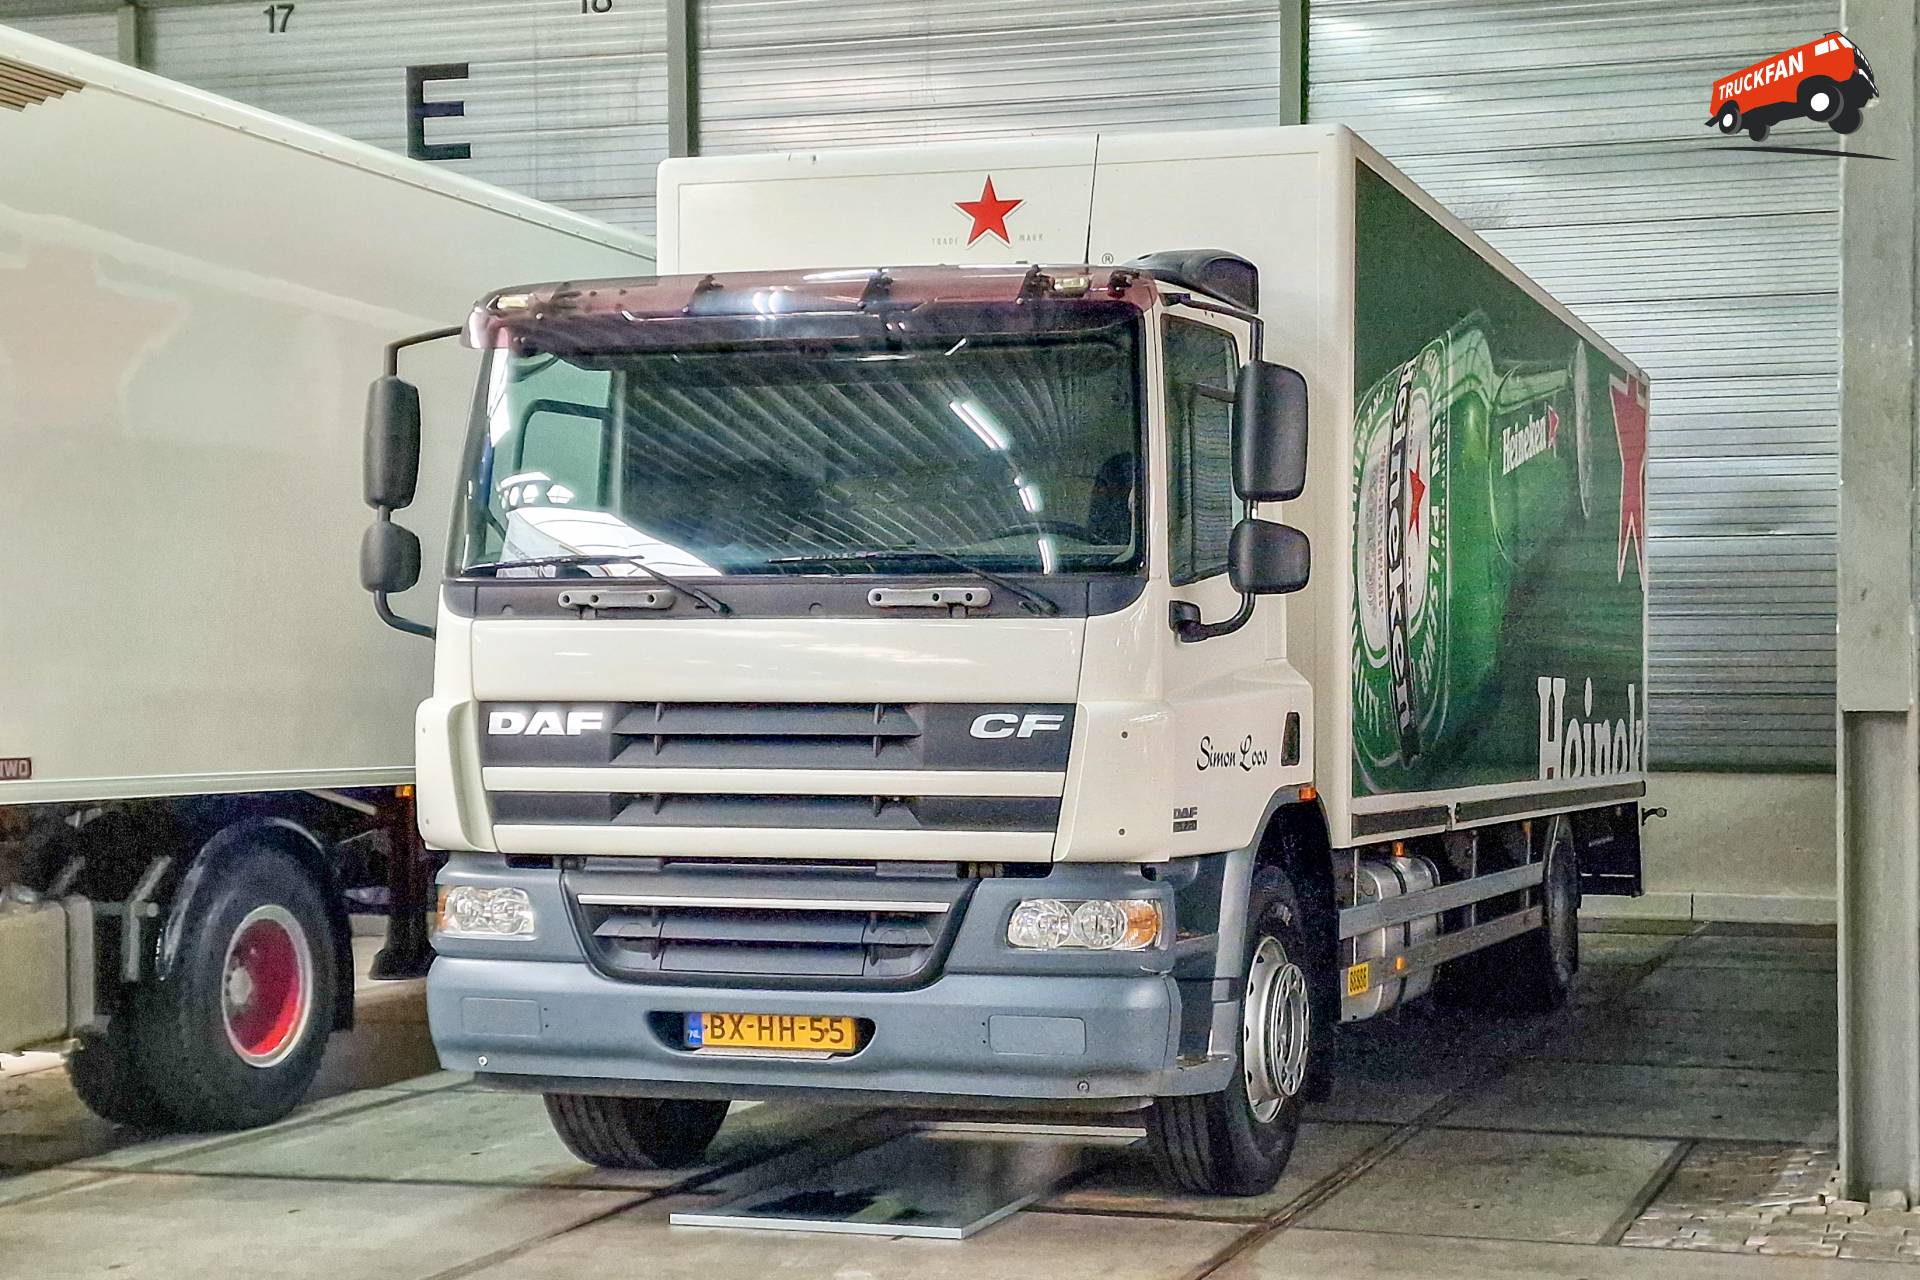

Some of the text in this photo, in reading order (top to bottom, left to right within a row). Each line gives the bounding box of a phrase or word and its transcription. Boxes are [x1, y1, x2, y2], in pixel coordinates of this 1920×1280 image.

[263, 4, 295, 33] 17
[405, 62, 472, 160] E
[1502, 413, 1548, 476] Heineken
[1387, 357, 1417, 731] Heineken
[488, 711, 604, 736] DAF
[969, 713, 1065, 739] CF
[1196, 734, 1268, 772] Simon Loos
[1173, 806, 1198, 819] DAF
[709, 1014, 845, 1044] BX-HH-55
